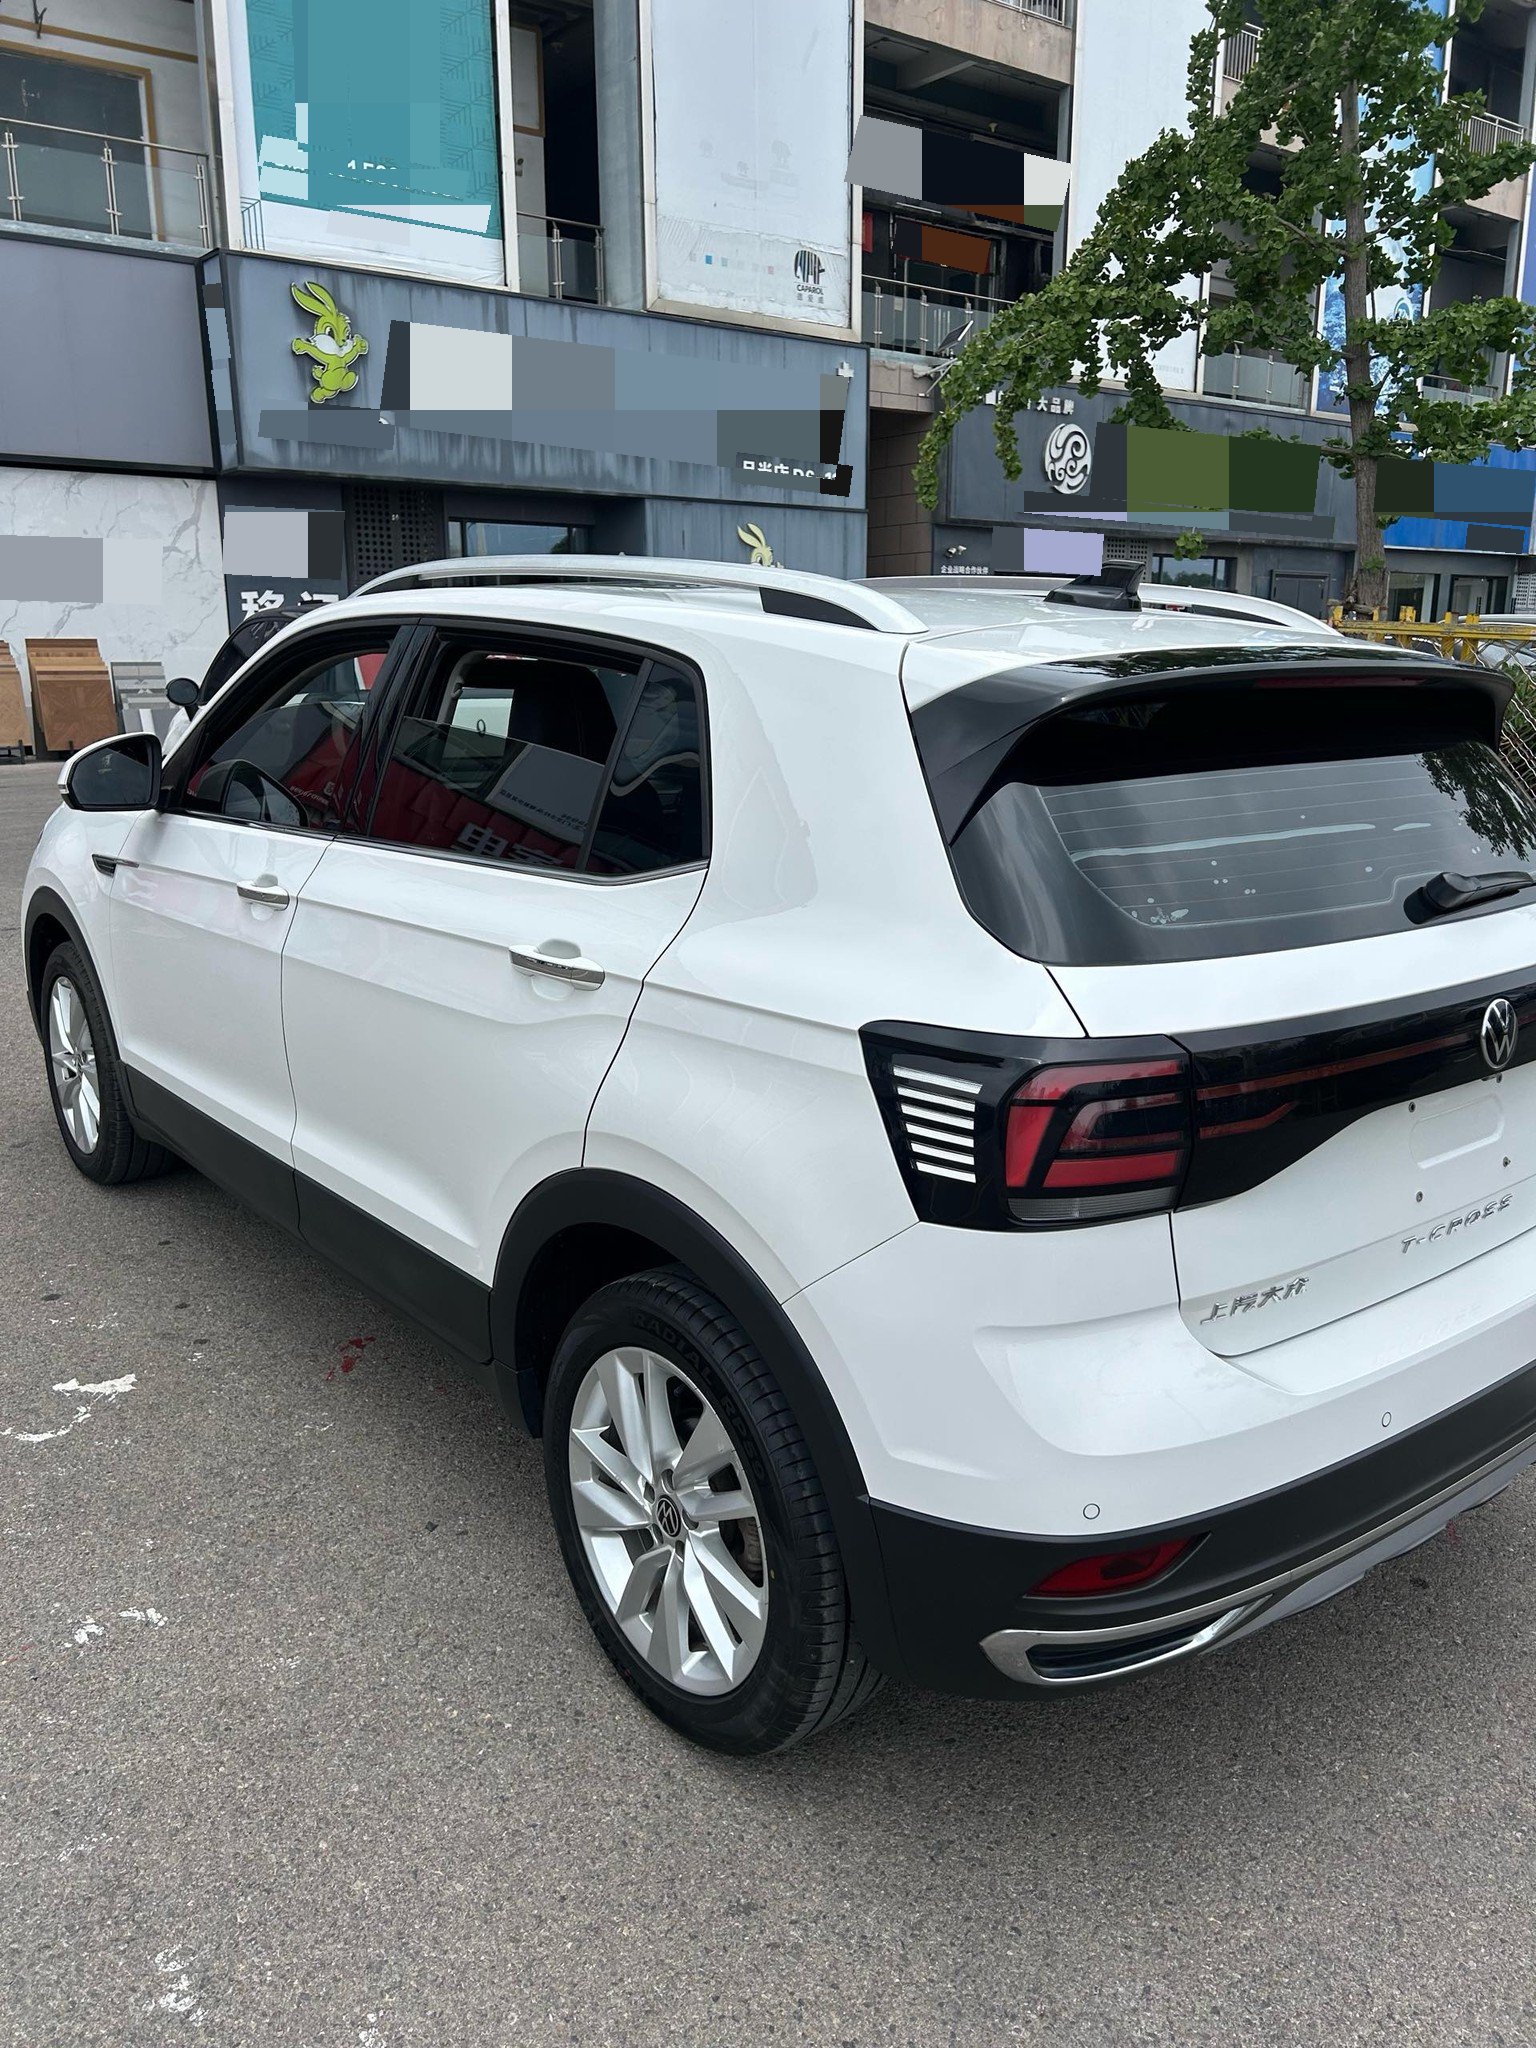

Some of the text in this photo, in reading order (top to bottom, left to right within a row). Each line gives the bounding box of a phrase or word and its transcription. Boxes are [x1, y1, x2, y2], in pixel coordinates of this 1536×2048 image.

[796, 284, 824, 296] CAPAROL
[1401, 1193, 1514, 1254] T-CROSS
[1200, 1277, 1310, 1325] 上汽大众
